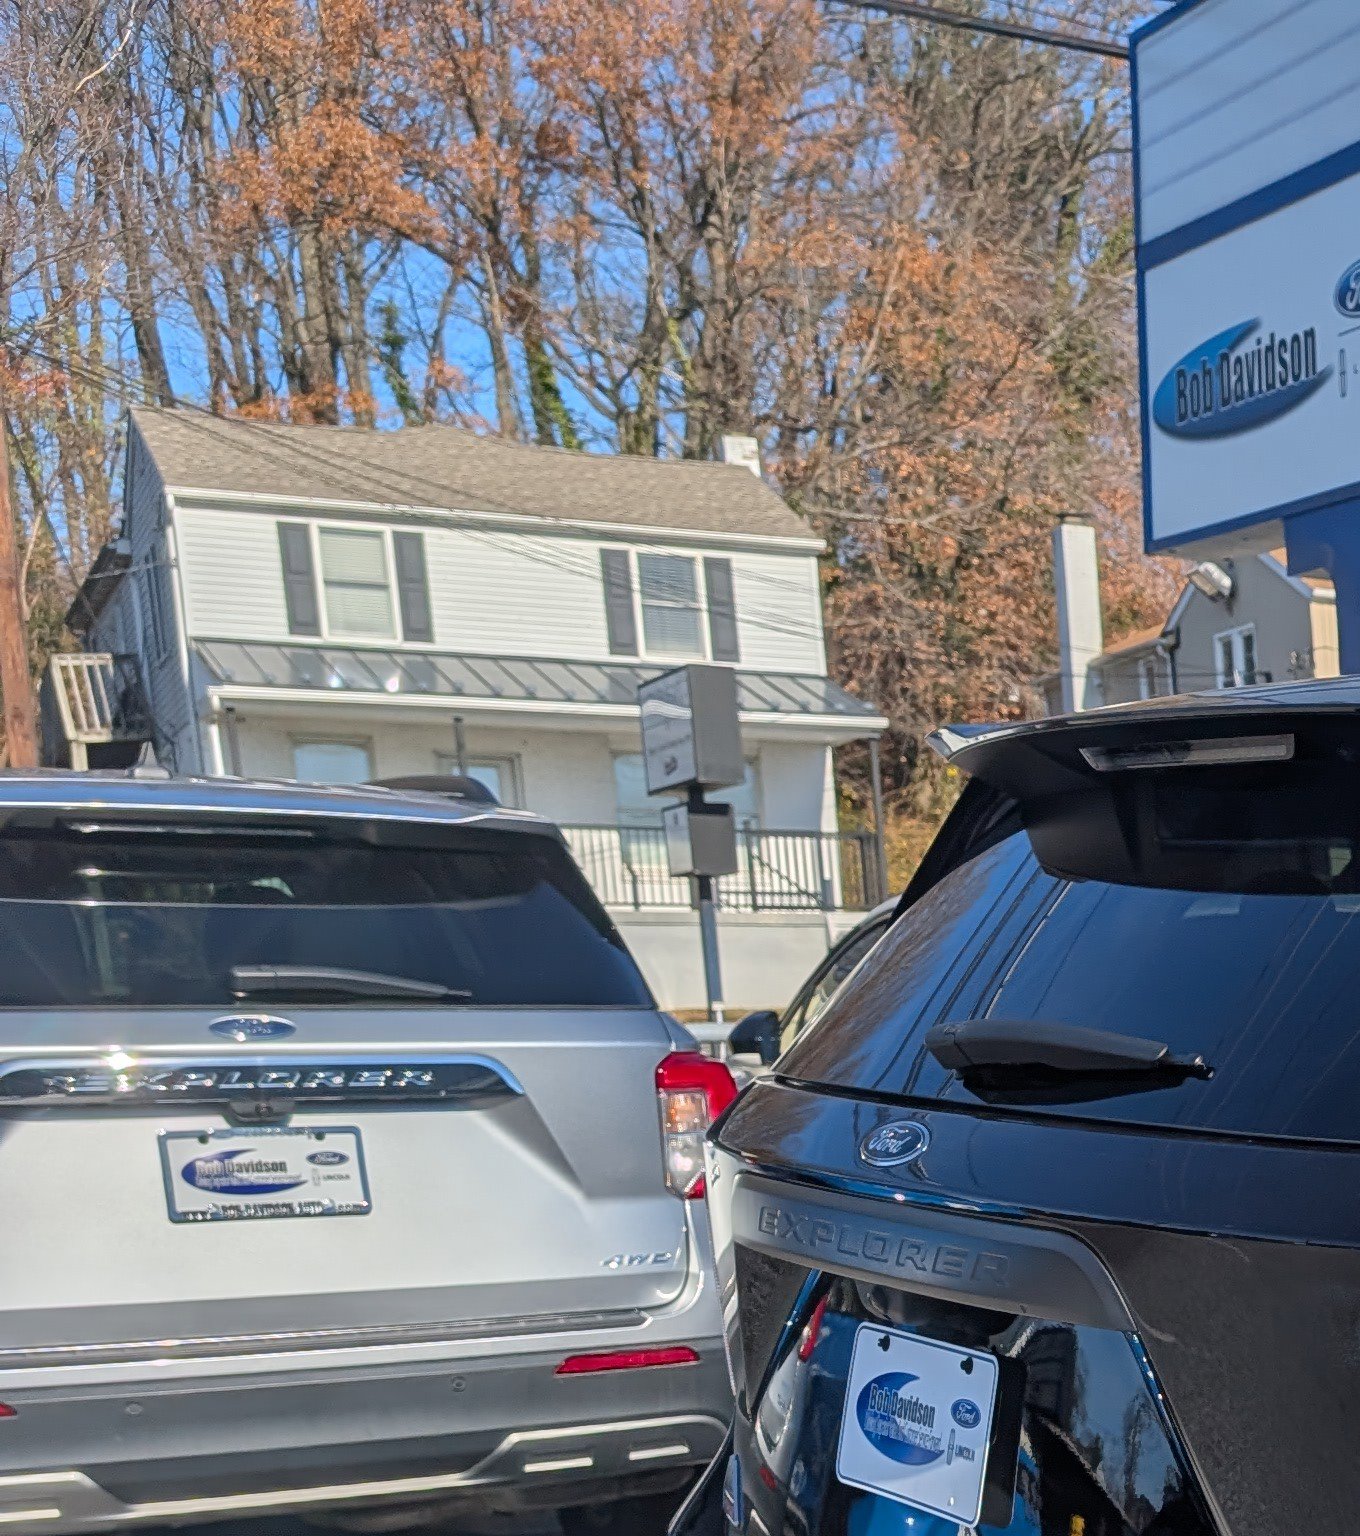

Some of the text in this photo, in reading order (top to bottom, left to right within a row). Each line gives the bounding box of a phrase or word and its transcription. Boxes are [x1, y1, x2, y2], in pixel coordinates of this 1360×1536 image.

[1175, 326, 1317, 424] Bob Davidson
[867, 1127, 912, 1154] Ford
[225, 1159, 288, 1174] Davidson
[758, 1206, 1012, 1288] EXPLORER
[869, 1383, 936, 1429] Bob Davidson
[956, 1402, 976, 1423] Ford
